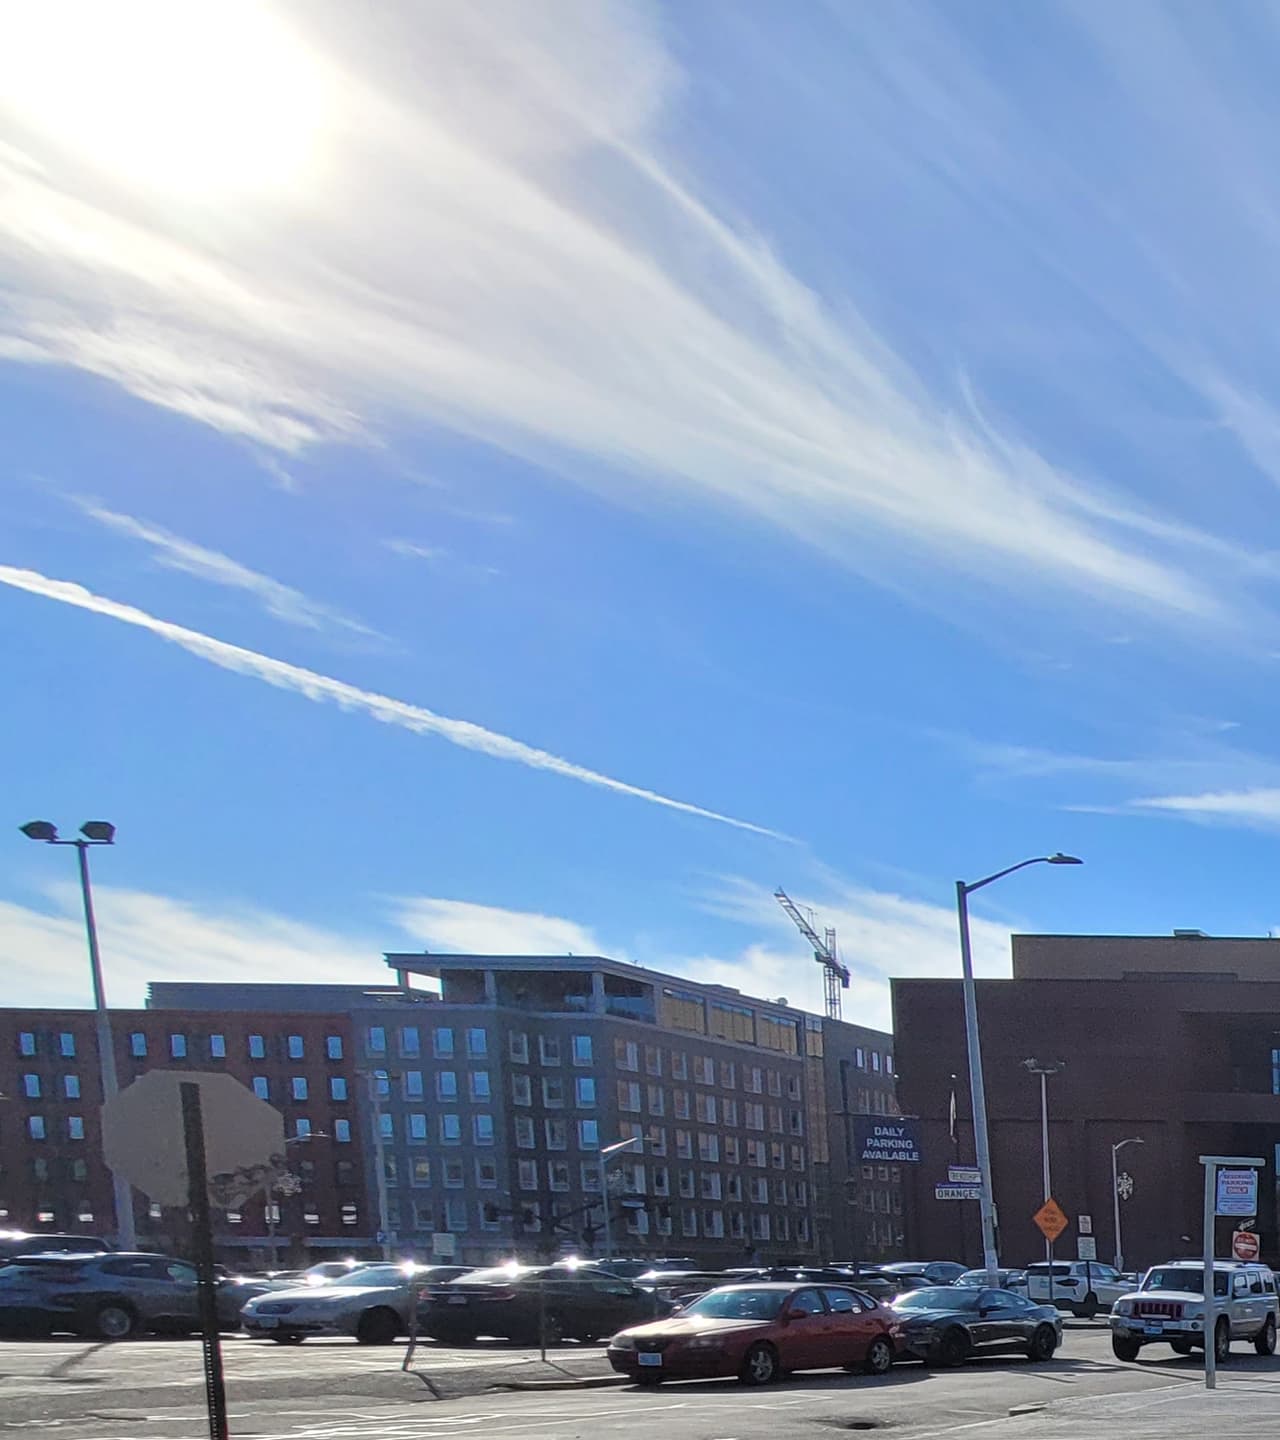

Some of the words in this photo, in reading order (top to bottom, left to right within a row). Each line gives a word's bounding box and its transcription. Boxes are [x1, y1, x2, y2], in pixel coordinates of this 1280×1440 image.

[874, 1127, 904, 1137] DAILY
[866, 1138, 913, 1149] PARKING
[862, 1150, 920, 1160] AVAILABLE
[937, 1189, 975, 1198] ORANGE
[1227, 1186, 1248, 1194] ONLY
